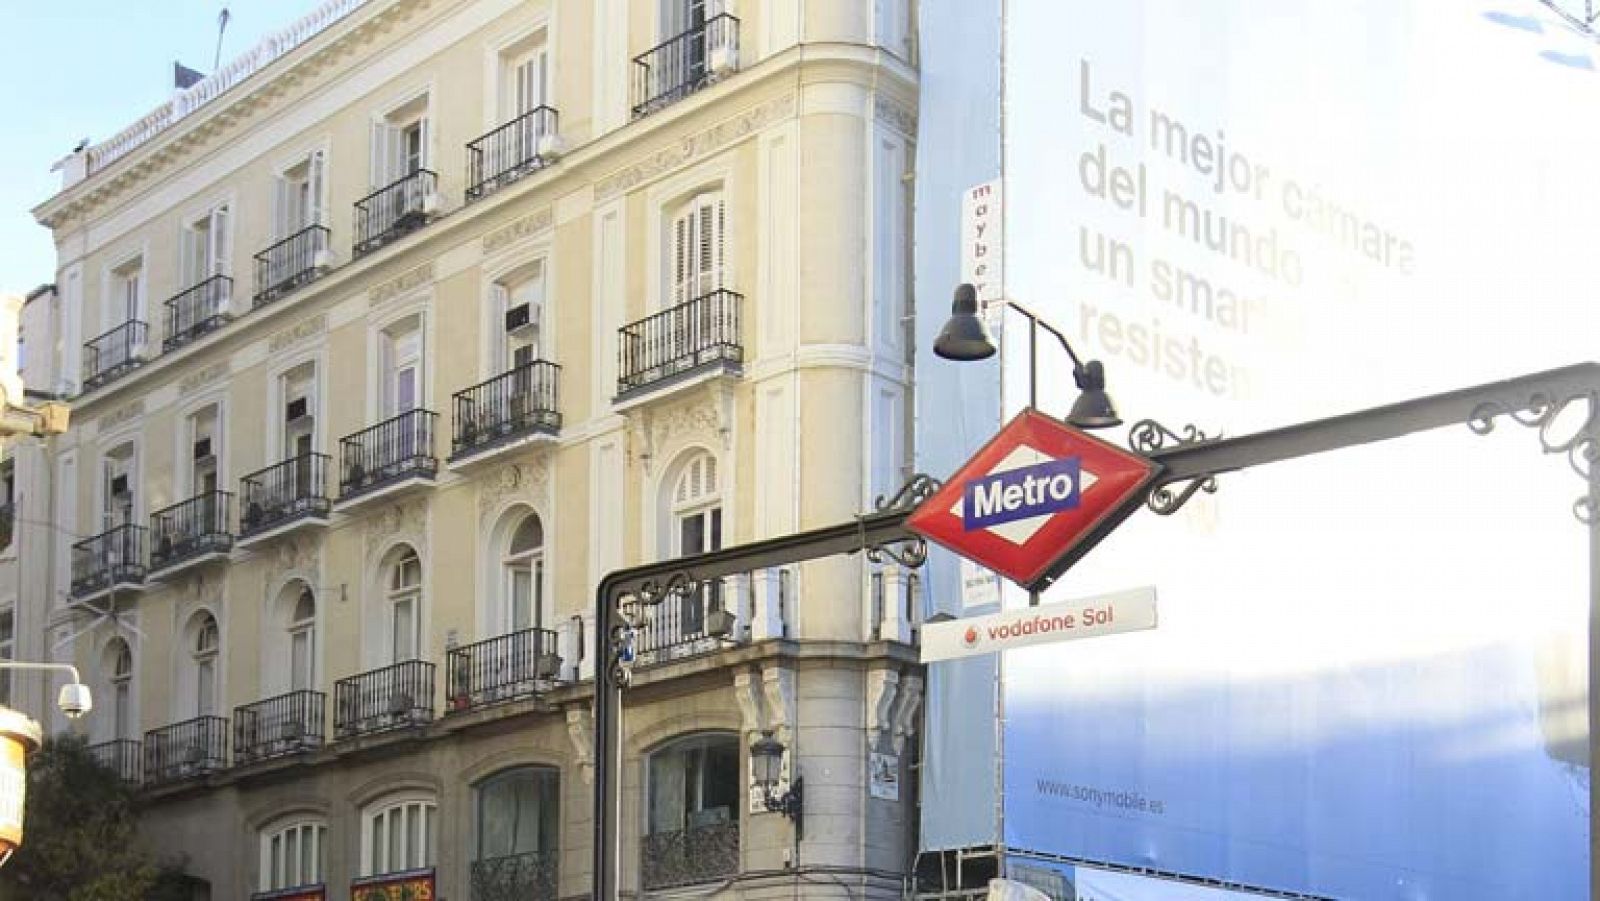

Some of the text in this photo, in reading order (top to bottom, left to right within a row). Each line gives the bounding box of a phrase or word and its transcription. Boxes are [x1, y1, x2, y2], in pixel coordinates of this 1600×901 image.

[1079, 58, 1134, 137] La
[1149, 108, 1270, 200] mejor
[1078, 144, 1147, 218] del
[1162, 189, 1304, 288] mundo
[1078, 225, 1135, 288] un
[974, 473, 1073, 519] Metro
[988, 605, 1114, 640] vodafone Sol
[1036, 778, 1164, 815] www.sonymobile.es
